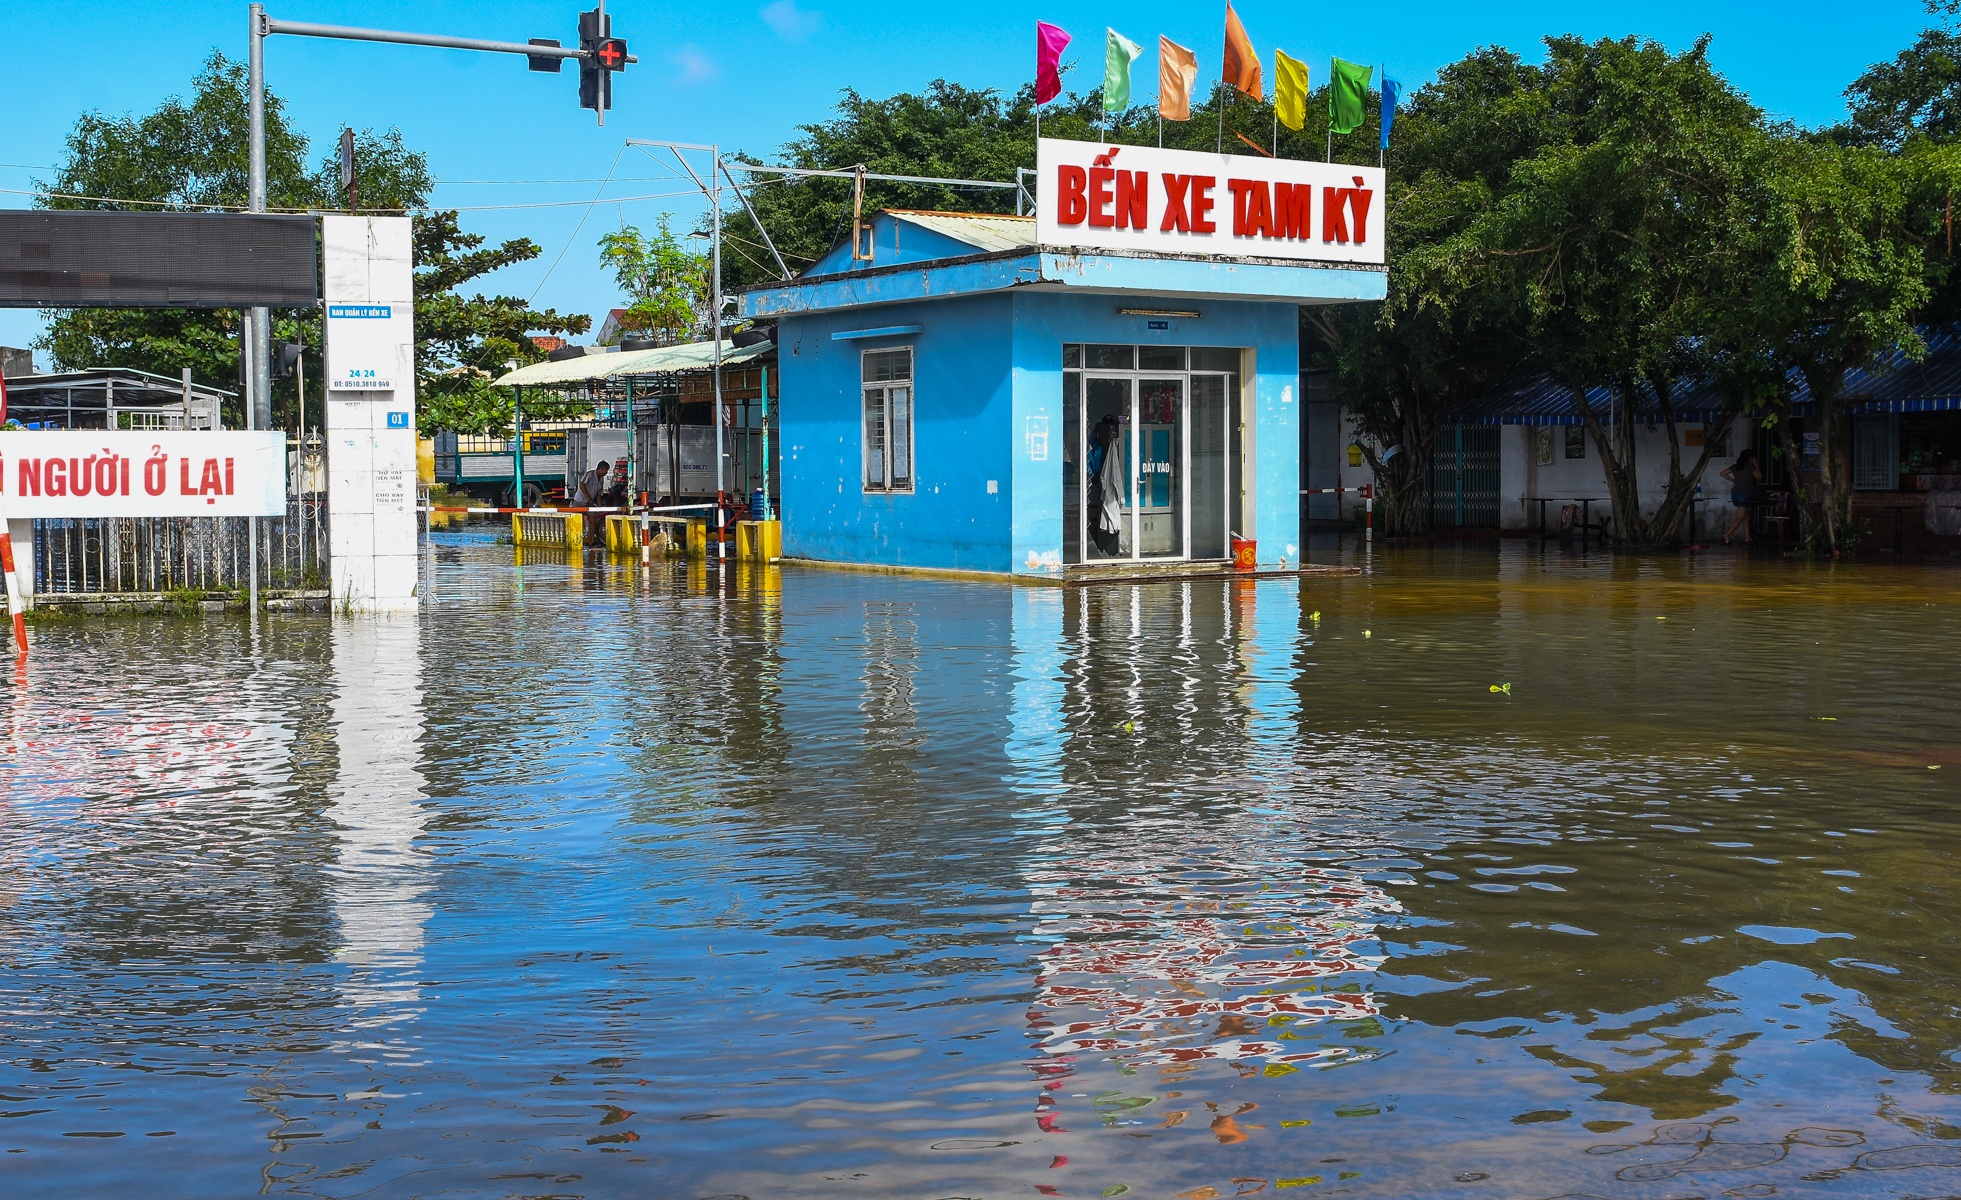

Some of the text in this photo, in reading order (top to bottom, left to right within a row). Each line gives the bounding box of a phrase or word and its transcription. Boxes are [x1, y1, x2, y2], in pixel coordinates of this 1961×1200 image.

[1057, 147, 1374, 244] BẾN XE TAM KỲ
[331, 308, 344, 316] BAN
[344, 380, 377, 388] 0510.3810
[391, 414, 403, 424] 01
[1156, 460, 1170, 473] VÀO
[18, 447, 130, 497] NGƯỜI
[143, 444, 168, 497] Ở
[180, 457, 235, 504] LẠI
